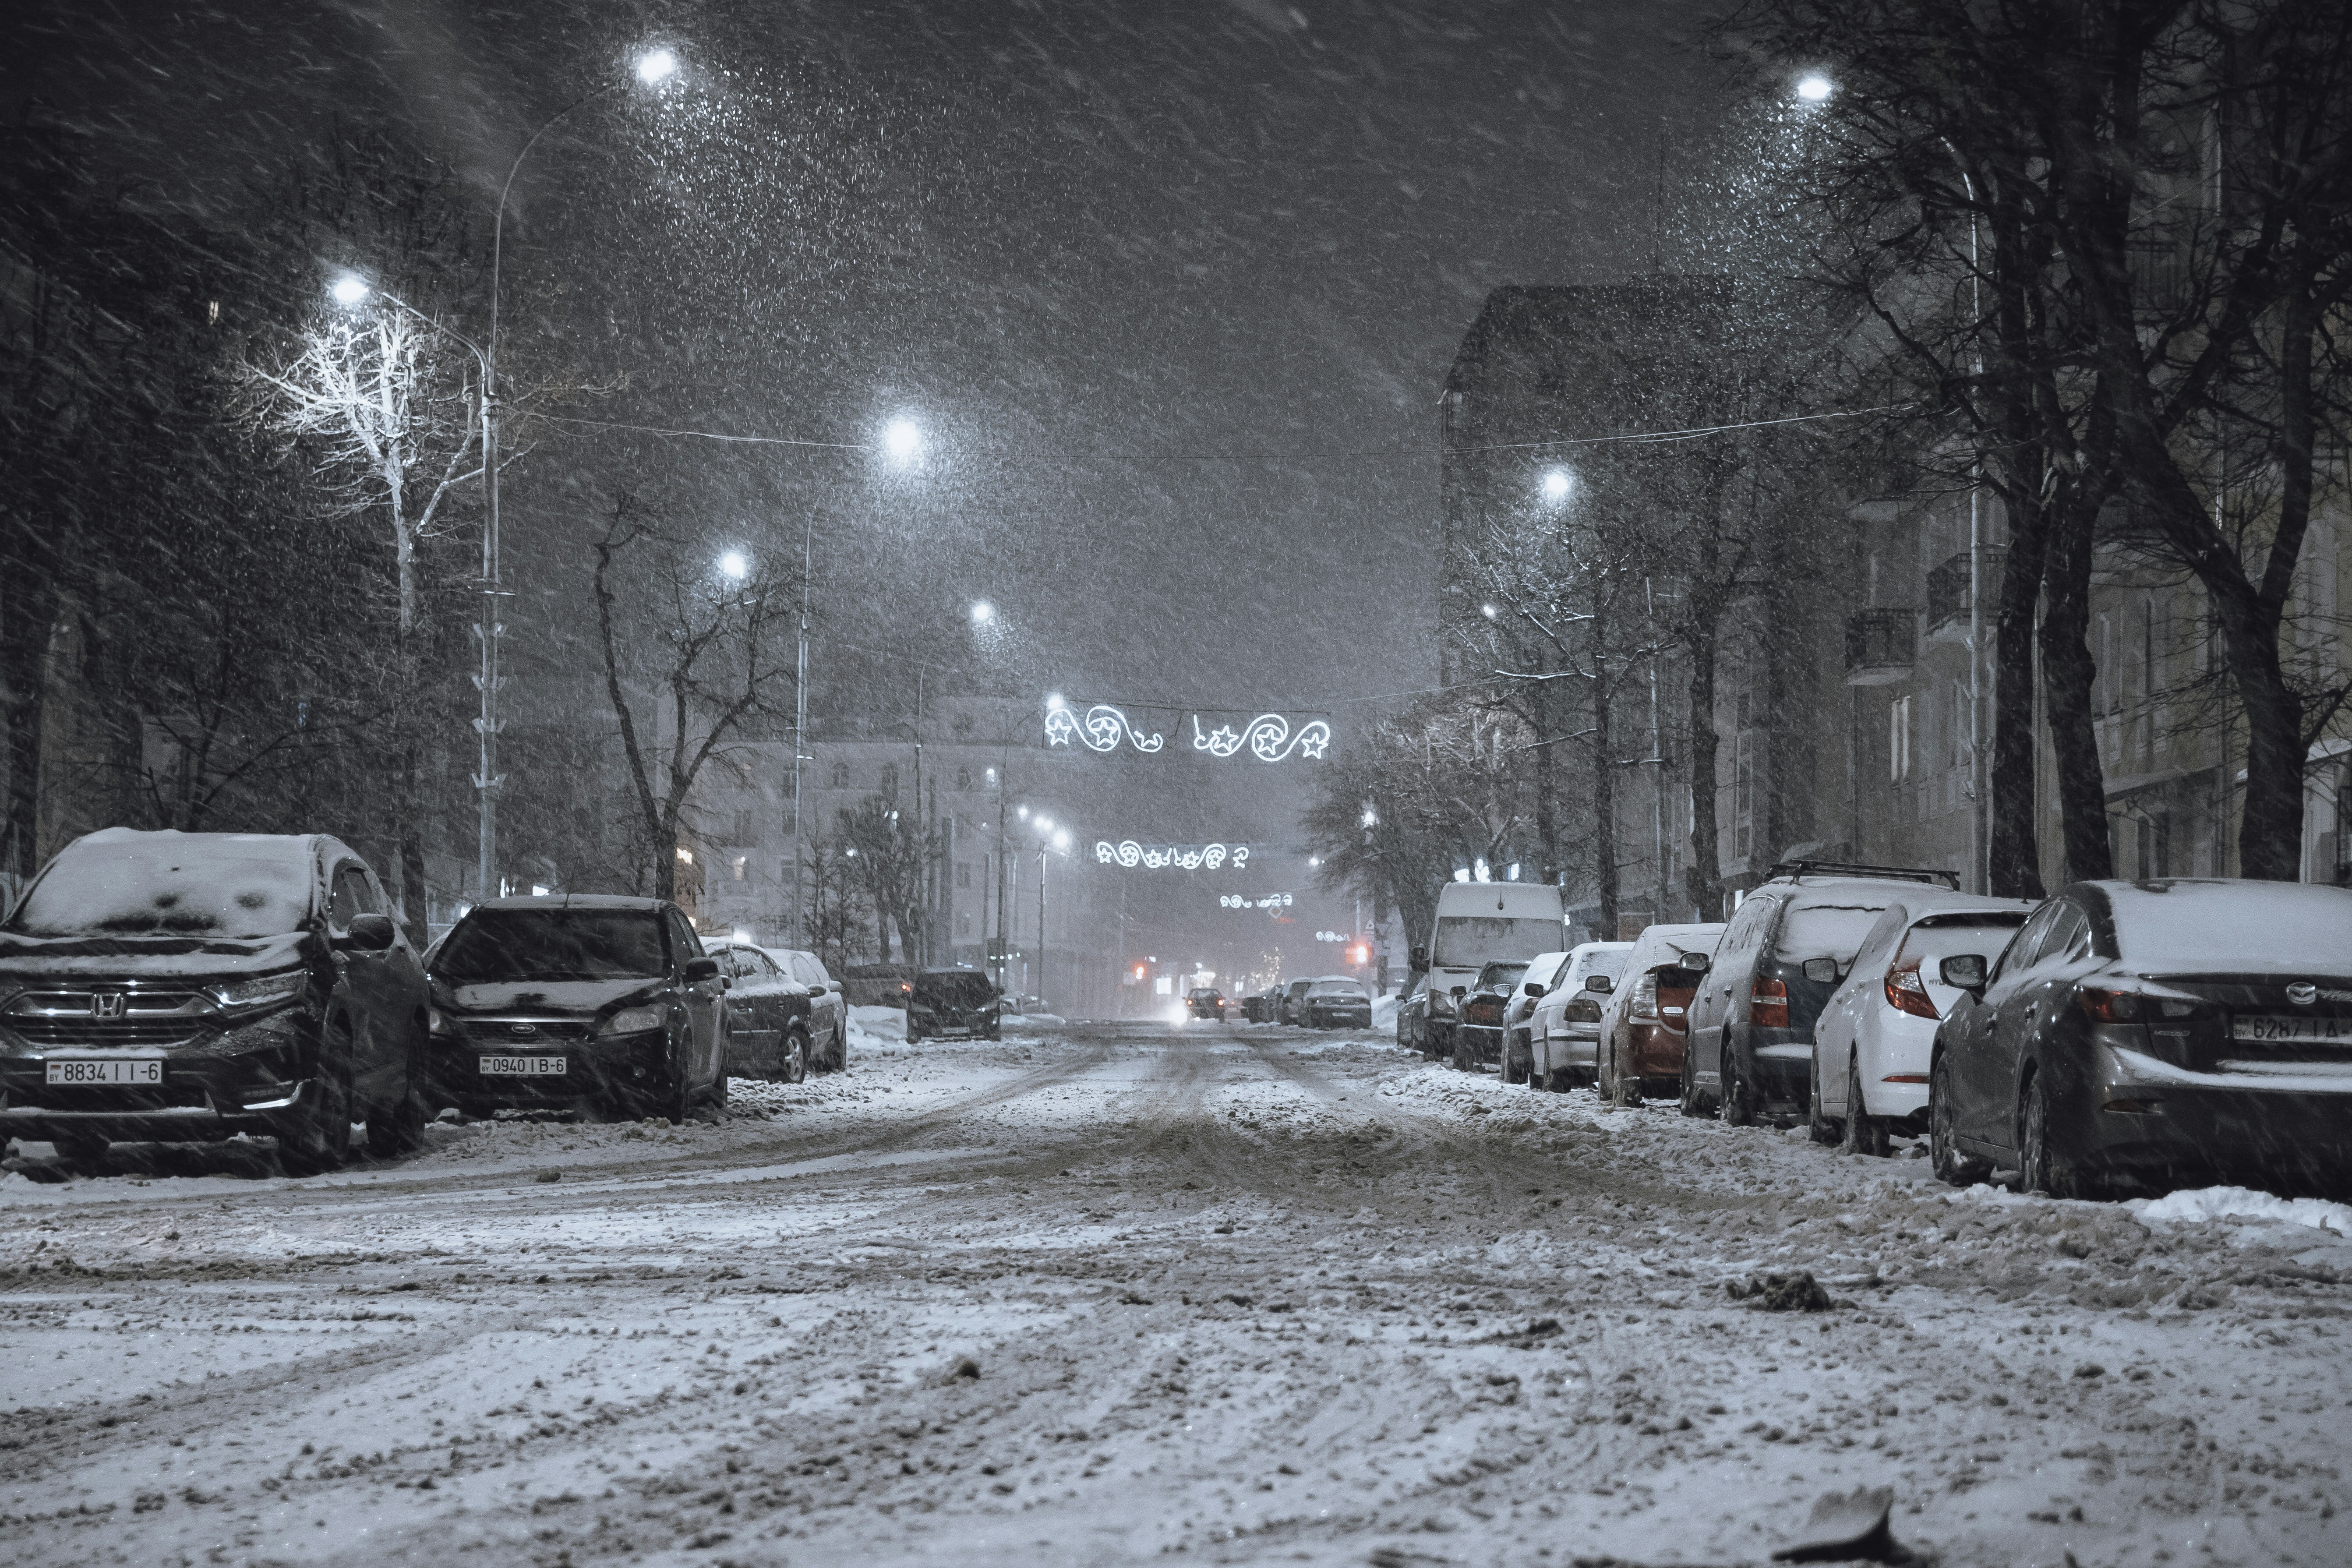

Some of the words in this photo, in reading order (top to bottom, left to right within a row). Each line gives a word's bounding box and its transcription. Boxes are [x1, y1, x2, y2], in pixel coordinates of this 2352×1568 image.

[64, 1063, 106, 1081] 8834
[493, 1058, 525, 1072] 0940
[531, 1059, 564, 1072] IB-6
